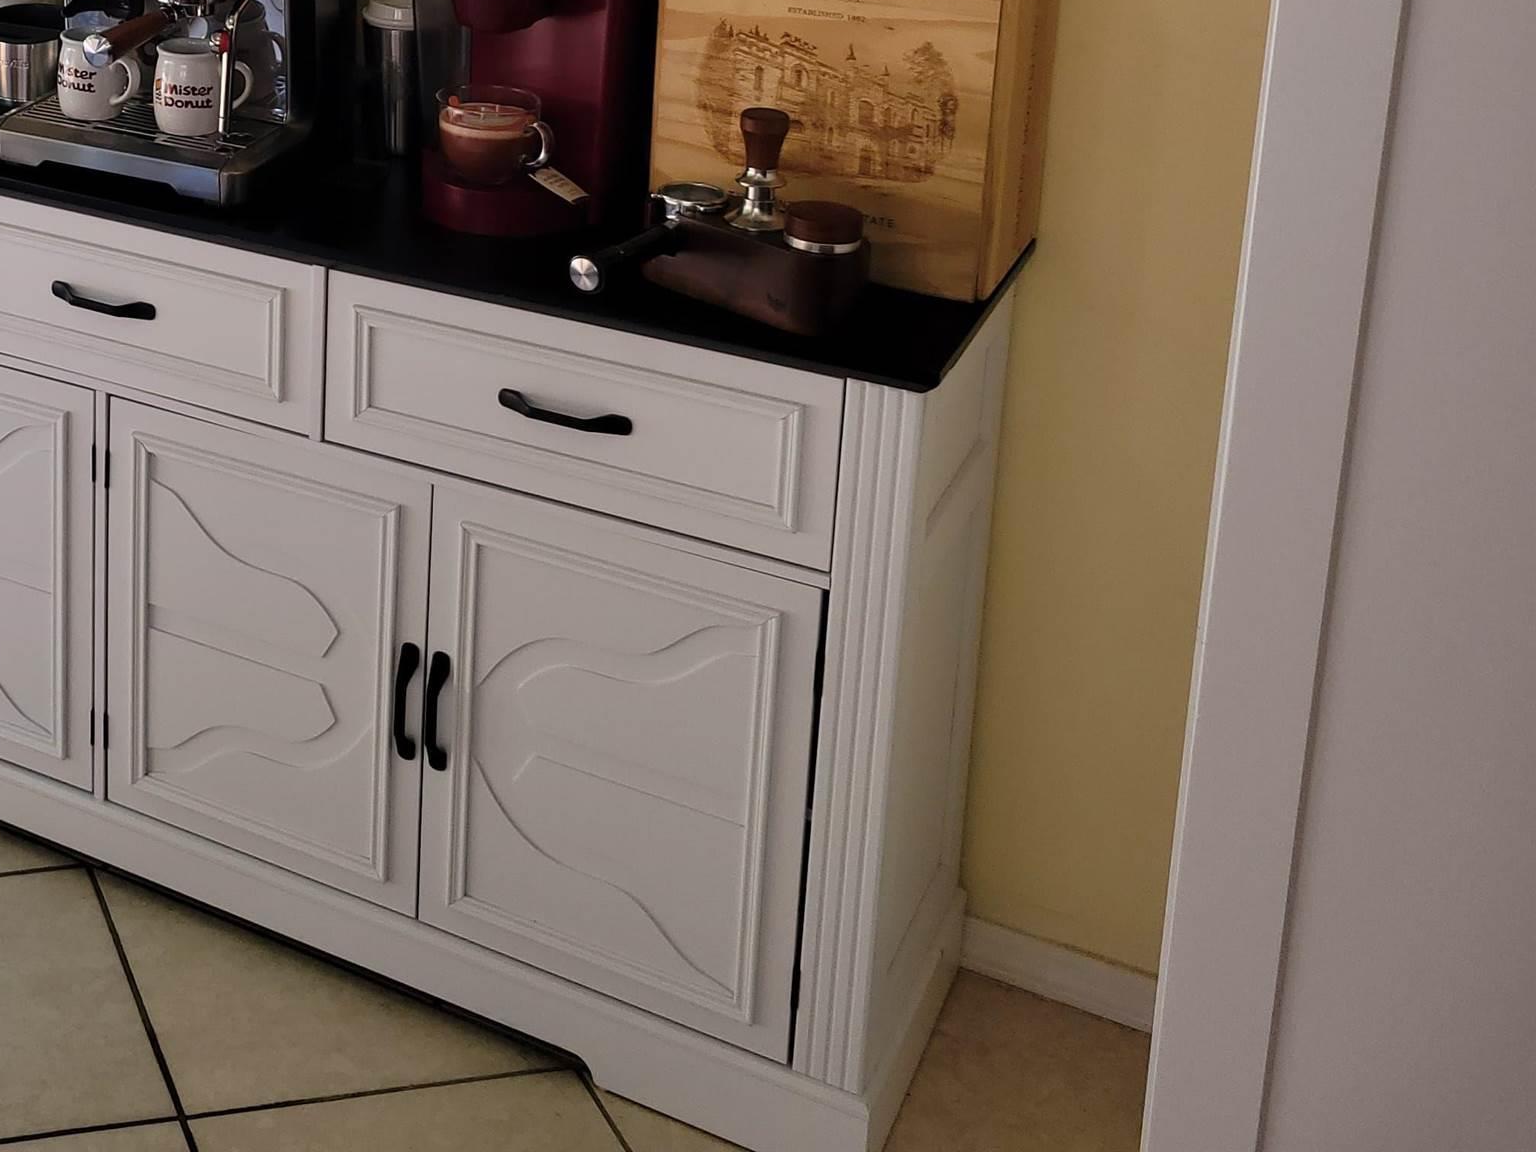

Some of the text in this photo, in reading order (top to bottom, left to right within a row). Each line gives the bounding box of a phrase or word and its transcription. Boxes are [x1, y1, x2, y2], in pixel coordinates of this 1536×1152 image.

[58, 63, 97, 80] Mster
[57, 74, 96, 93] Donut
[164, 83, 214, 96] Mister
[164, 95, 213, 109] Donut
